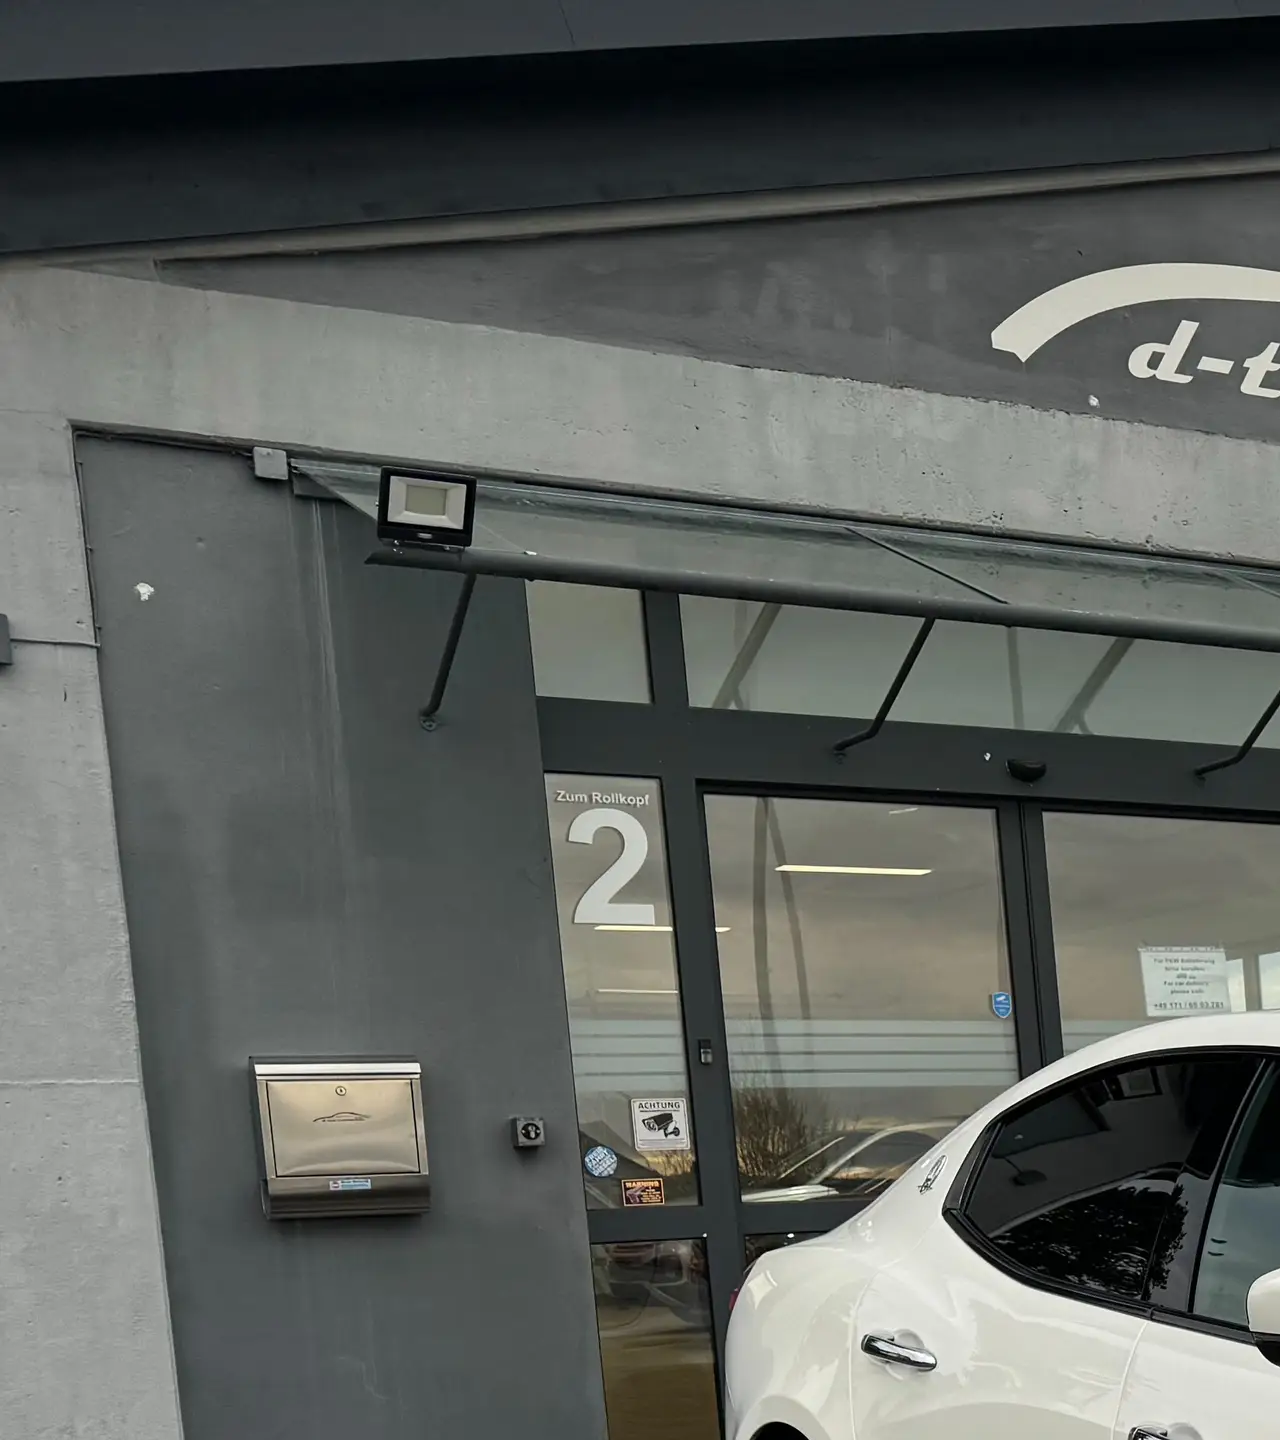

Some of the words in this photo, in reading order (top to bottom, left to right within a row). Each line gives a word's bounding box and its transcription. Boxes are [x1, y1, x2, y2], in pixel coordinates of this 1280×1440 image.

[556, 790, 588, 804] Zum
[591, 792, 650, 808] Rollkopf
[567, 808, 656, 925] 2
[638, 1101, 681, 1110] ACHTUNG
